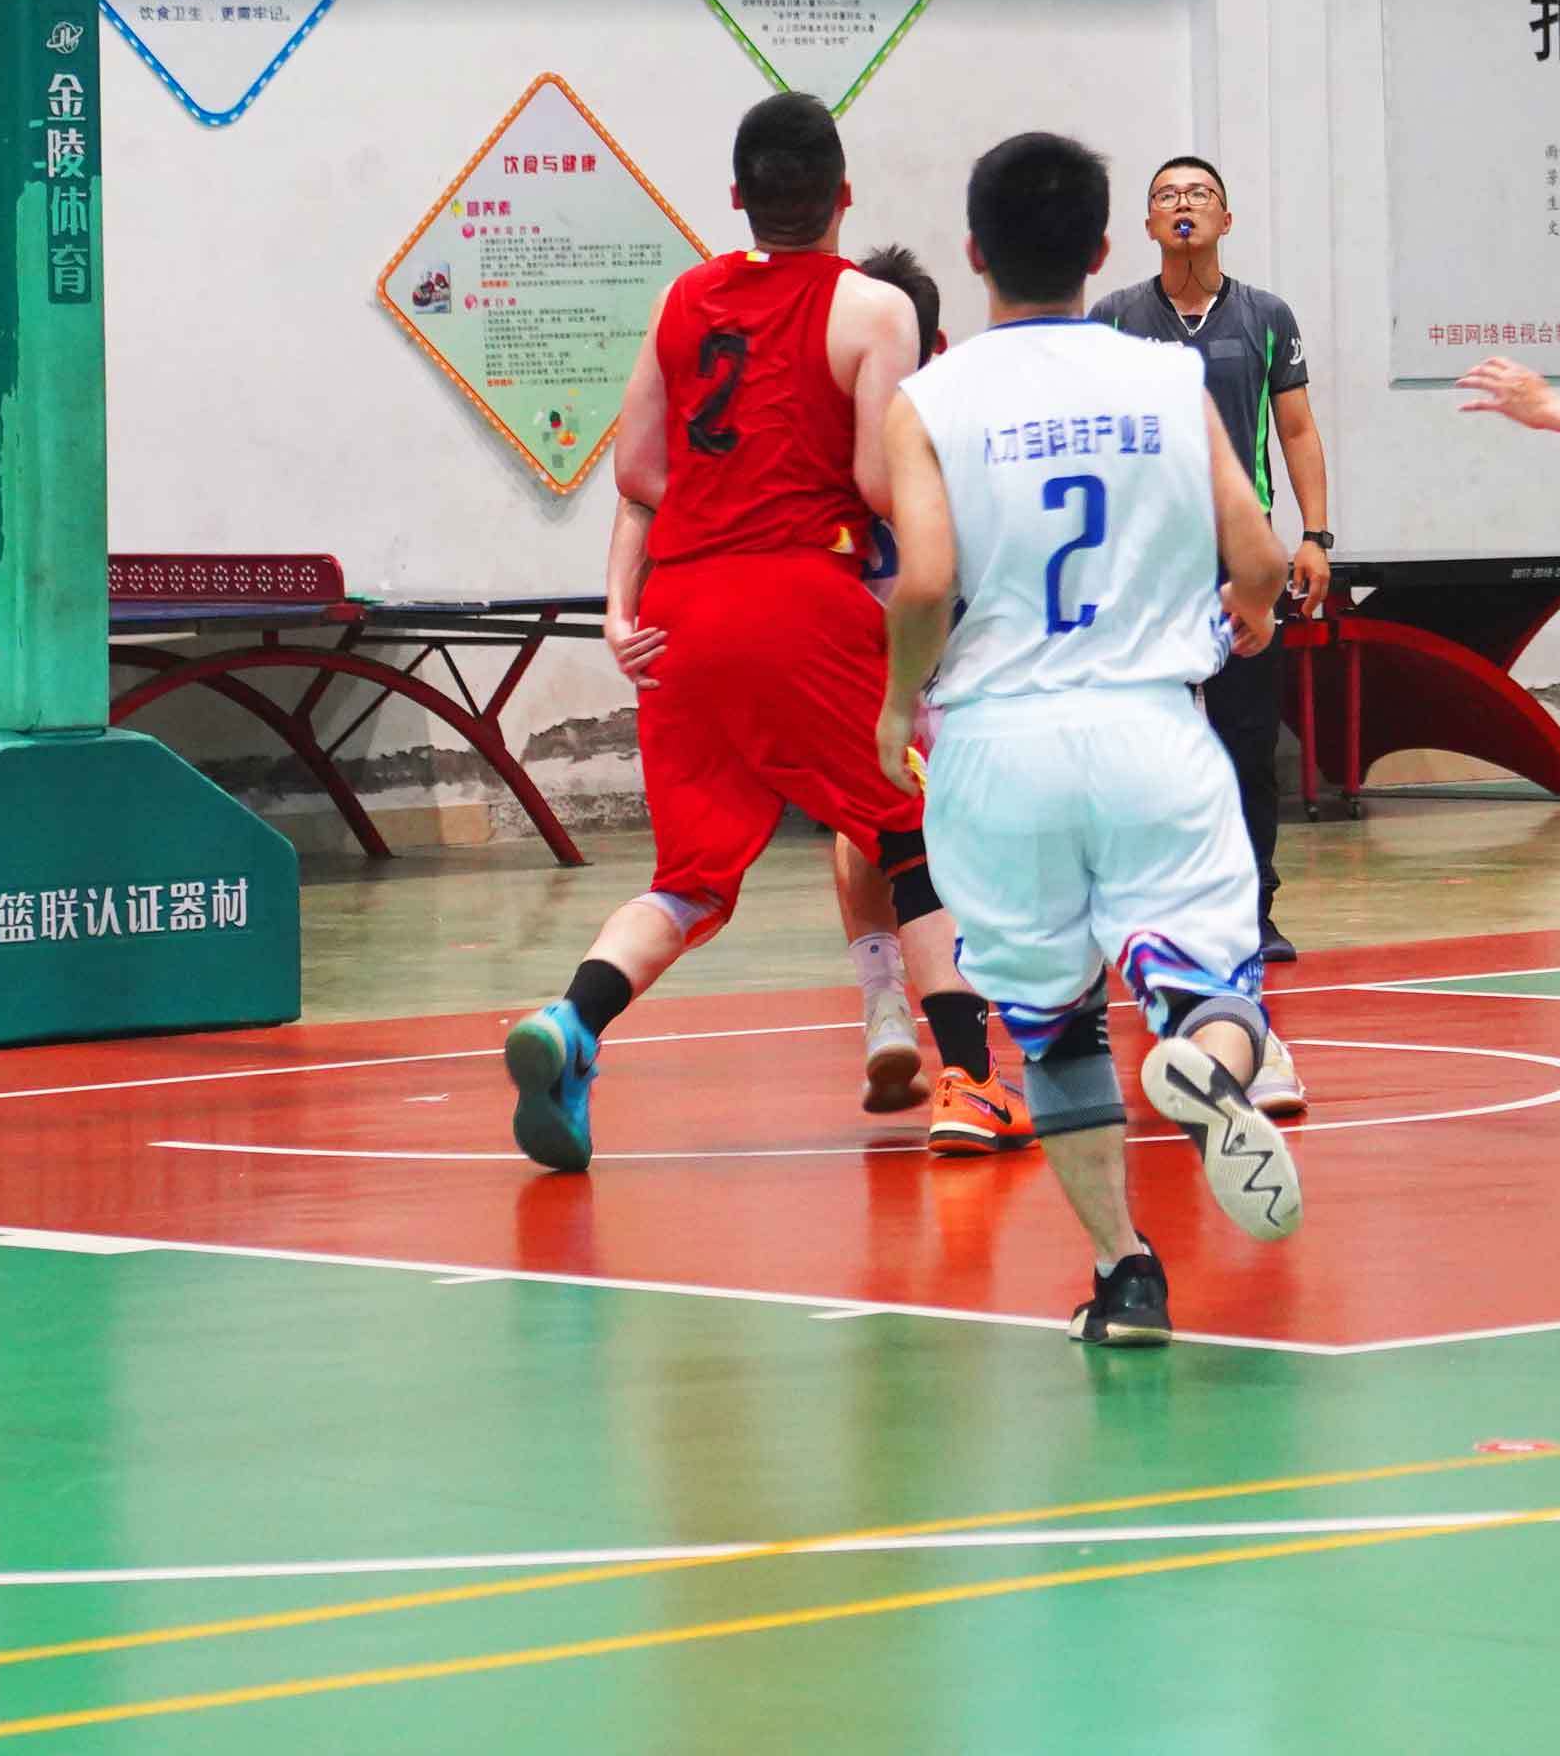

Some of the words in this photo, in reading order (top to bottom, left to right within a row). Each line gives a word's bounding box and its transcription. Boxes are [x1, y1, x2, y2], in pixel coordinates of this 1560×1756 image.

[47, 73, 89, 295] 金陵体育
[504, 155, 597, 174] 饮食与健康
[688, 330, 751, 456] 2
[1042, 474, 1107, 636] 2
